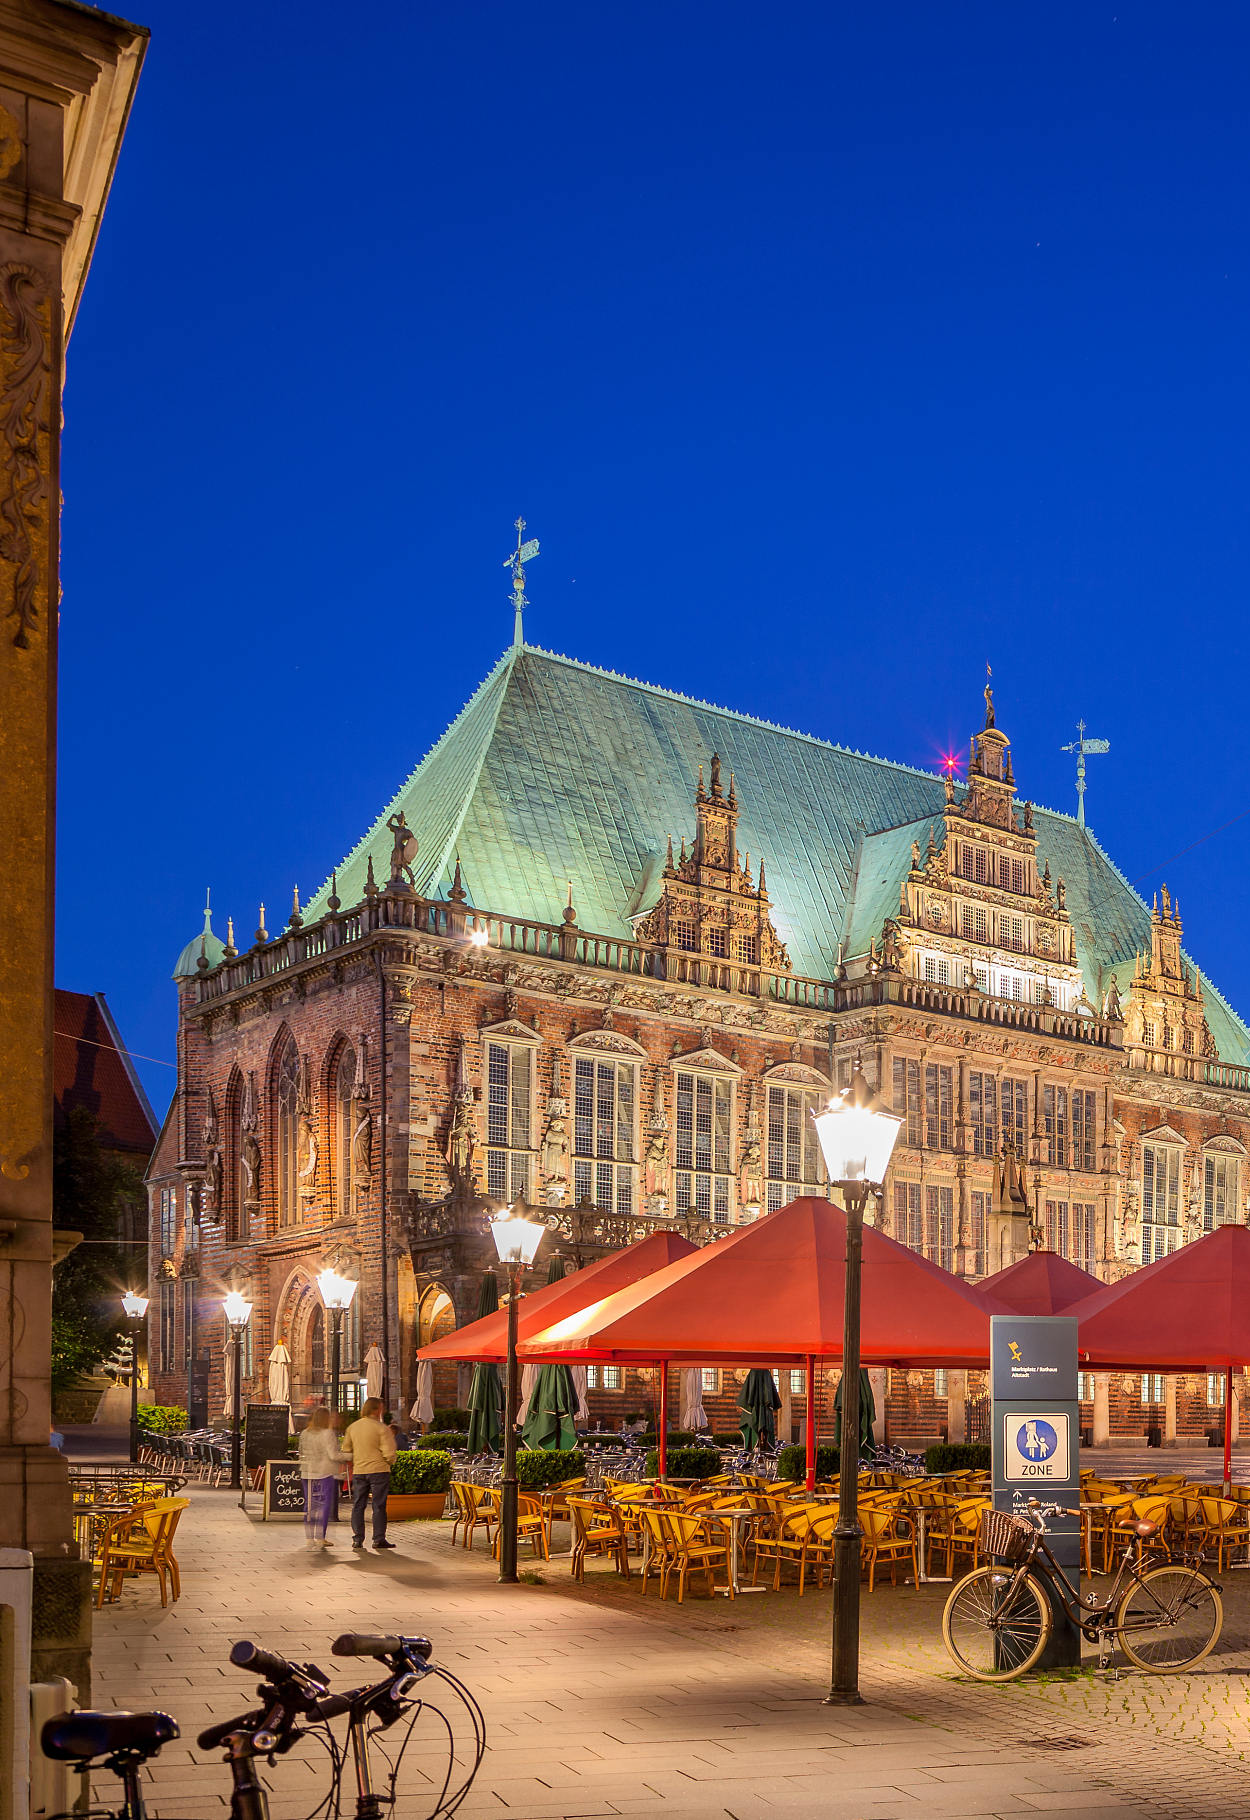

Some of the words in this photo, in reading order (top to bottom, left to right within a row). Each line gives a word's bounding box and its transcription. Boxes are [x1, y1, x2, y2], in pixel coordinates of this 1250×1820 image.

[1021, 1464, 1053, 1476] ZONE
[274, 1470, 302, 1483] Apple
[276, 1484, 301, 1496] Cider
[277, 1497, 305, 1508] €3,30
